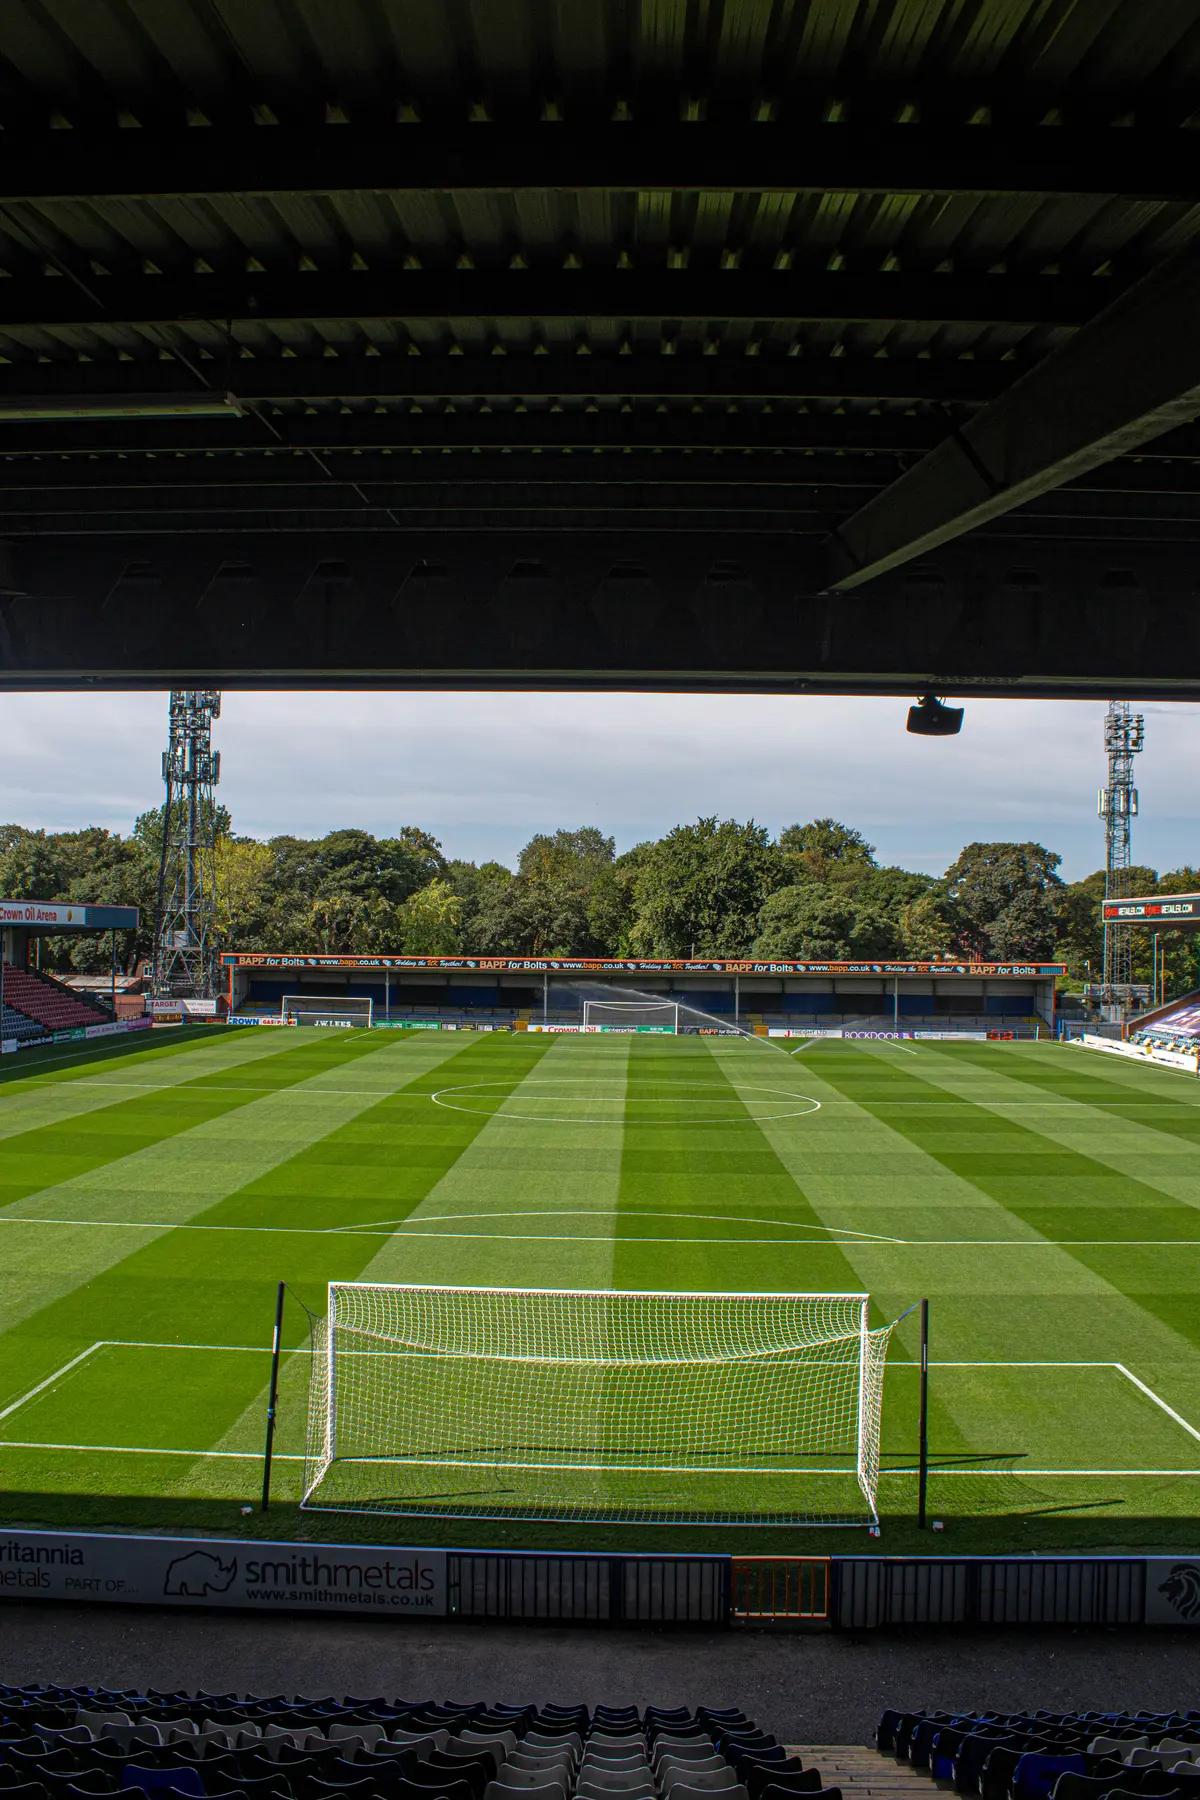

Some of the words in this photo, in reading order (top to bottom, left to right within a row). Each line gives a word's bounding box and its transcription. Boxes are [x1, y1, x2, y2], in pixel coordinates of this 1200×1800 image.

[0, 906, 24, 920] Crown
[25, 906, 36, 920] Oil
[36, 908, 57, 921] Arena
[239, 957, 264, 965] BAPP
[266, 957, 280, 965] for
[281, 957, 305, 966] Bolts
[319, 959, 380, 967] www.bapp.co.uk
[395, 959, 417, 968] Holding
[479, 960, 506, 969] BAPP
[508, 961, 522, 969] for
[523, 961, 548, 969] Bolts
[563, 962, 624, 970] www.bapp.co.uk
[640, 962, 662, 971] Holding
[725, 963, 752, 972] BAPP
[754, 964, 768, 972] for
[769, 964, 794, 972] Bolts
[809, 965, 870, 973] www.bapp.co.uk
[885, 965, 907, 973] Holding
[969, 966, 996, 974] BAPP
[997, 966, 1011, 974] for
[1012, 966, 1036, 975] Bolts
[228, 1017, 260, 1026] CROWN
[844, 1031, 899, 1039] ROCKDOOR
[245, 1554, 435, 1591] smithmetals
[65, 1577, 101, 1592] PART
[246, 1587, 435, 1607] www.smithmetals.co.uk
